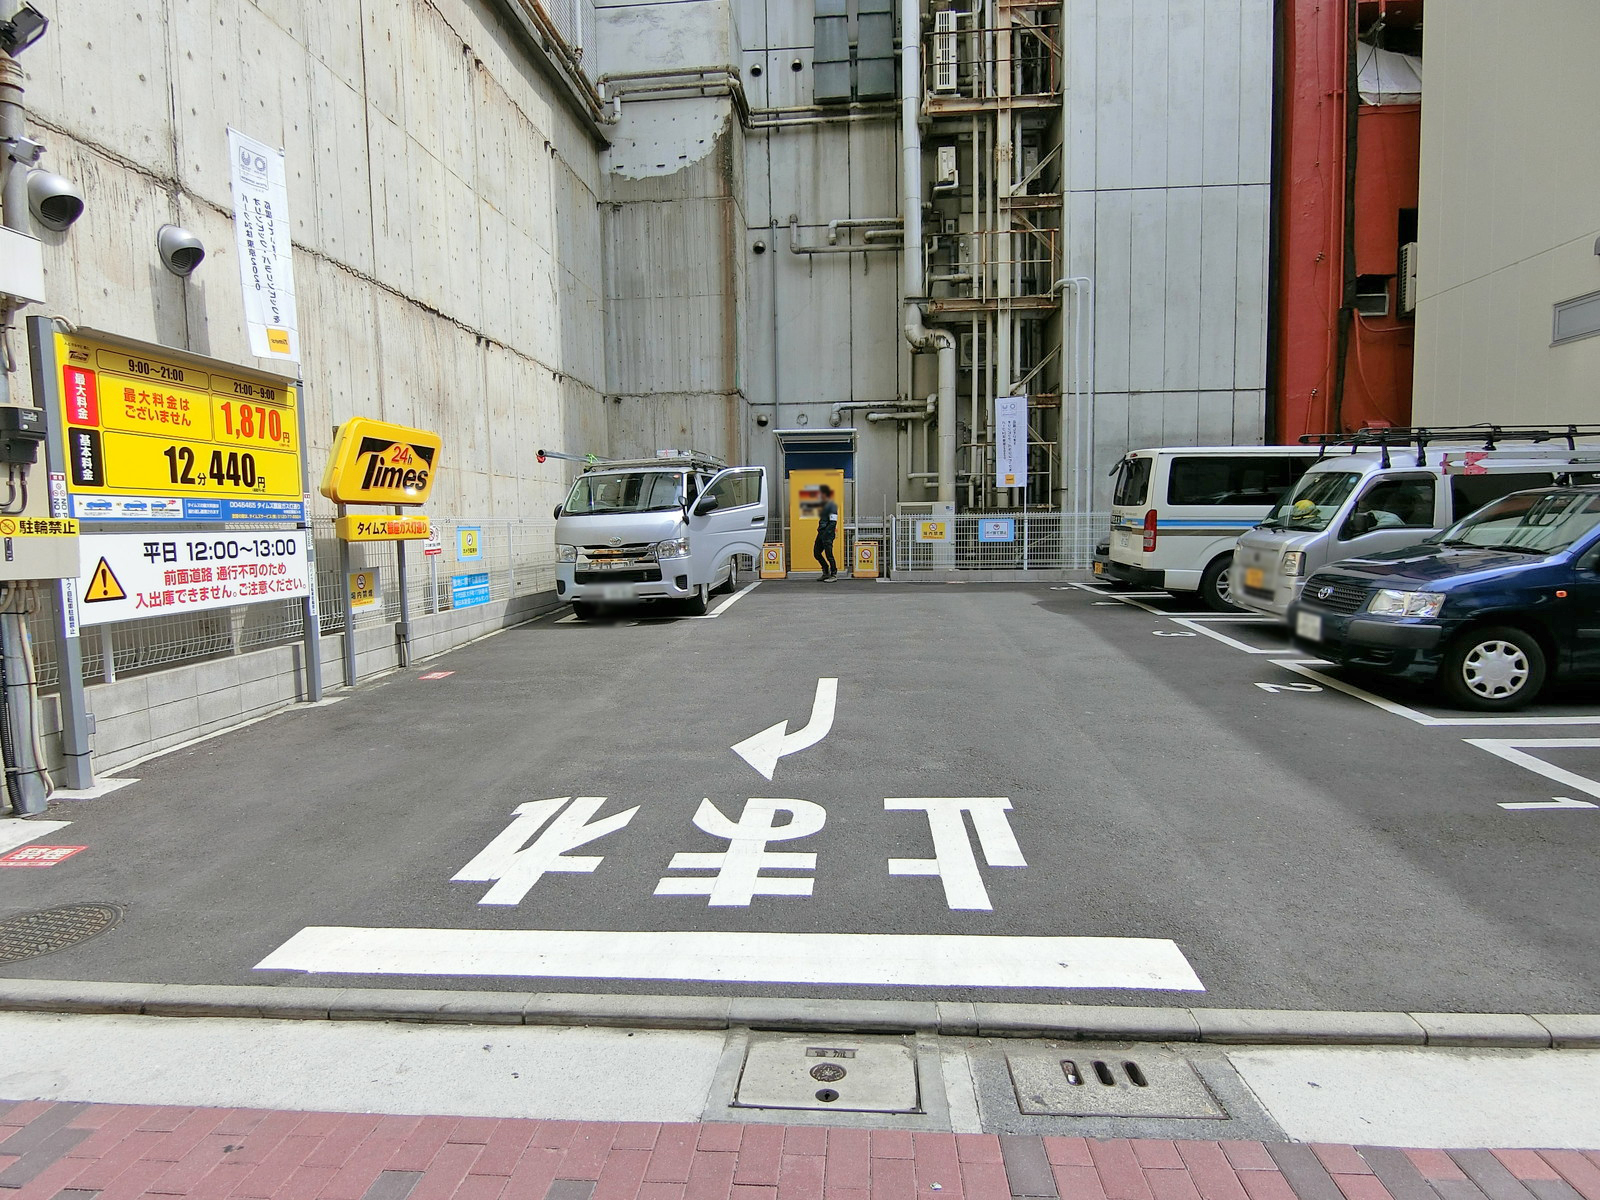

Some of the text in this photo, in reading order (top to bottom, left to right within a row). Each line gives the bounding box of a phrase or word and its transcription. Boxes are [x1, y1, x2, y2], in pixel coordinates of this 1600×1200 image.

[74, 373, 89, 420] 最大料金
[123, 388, 190, 411] 最大料金は
[125, 405, 191, 427] ございません
[79, 434, 94, 481] 基本料金
[361, 454, 429, 491] Times
[19, 520, 76, 535] 駐輪禁止
[143, 541, 177, 564] 平日
[164, 562, 287, 586] 前面道路 通行不可のため
[1253, 682, 1324, 693] 2
[1496, 796, 1599, 810] 1
[450, 796, 1028, 910] 止まれ
